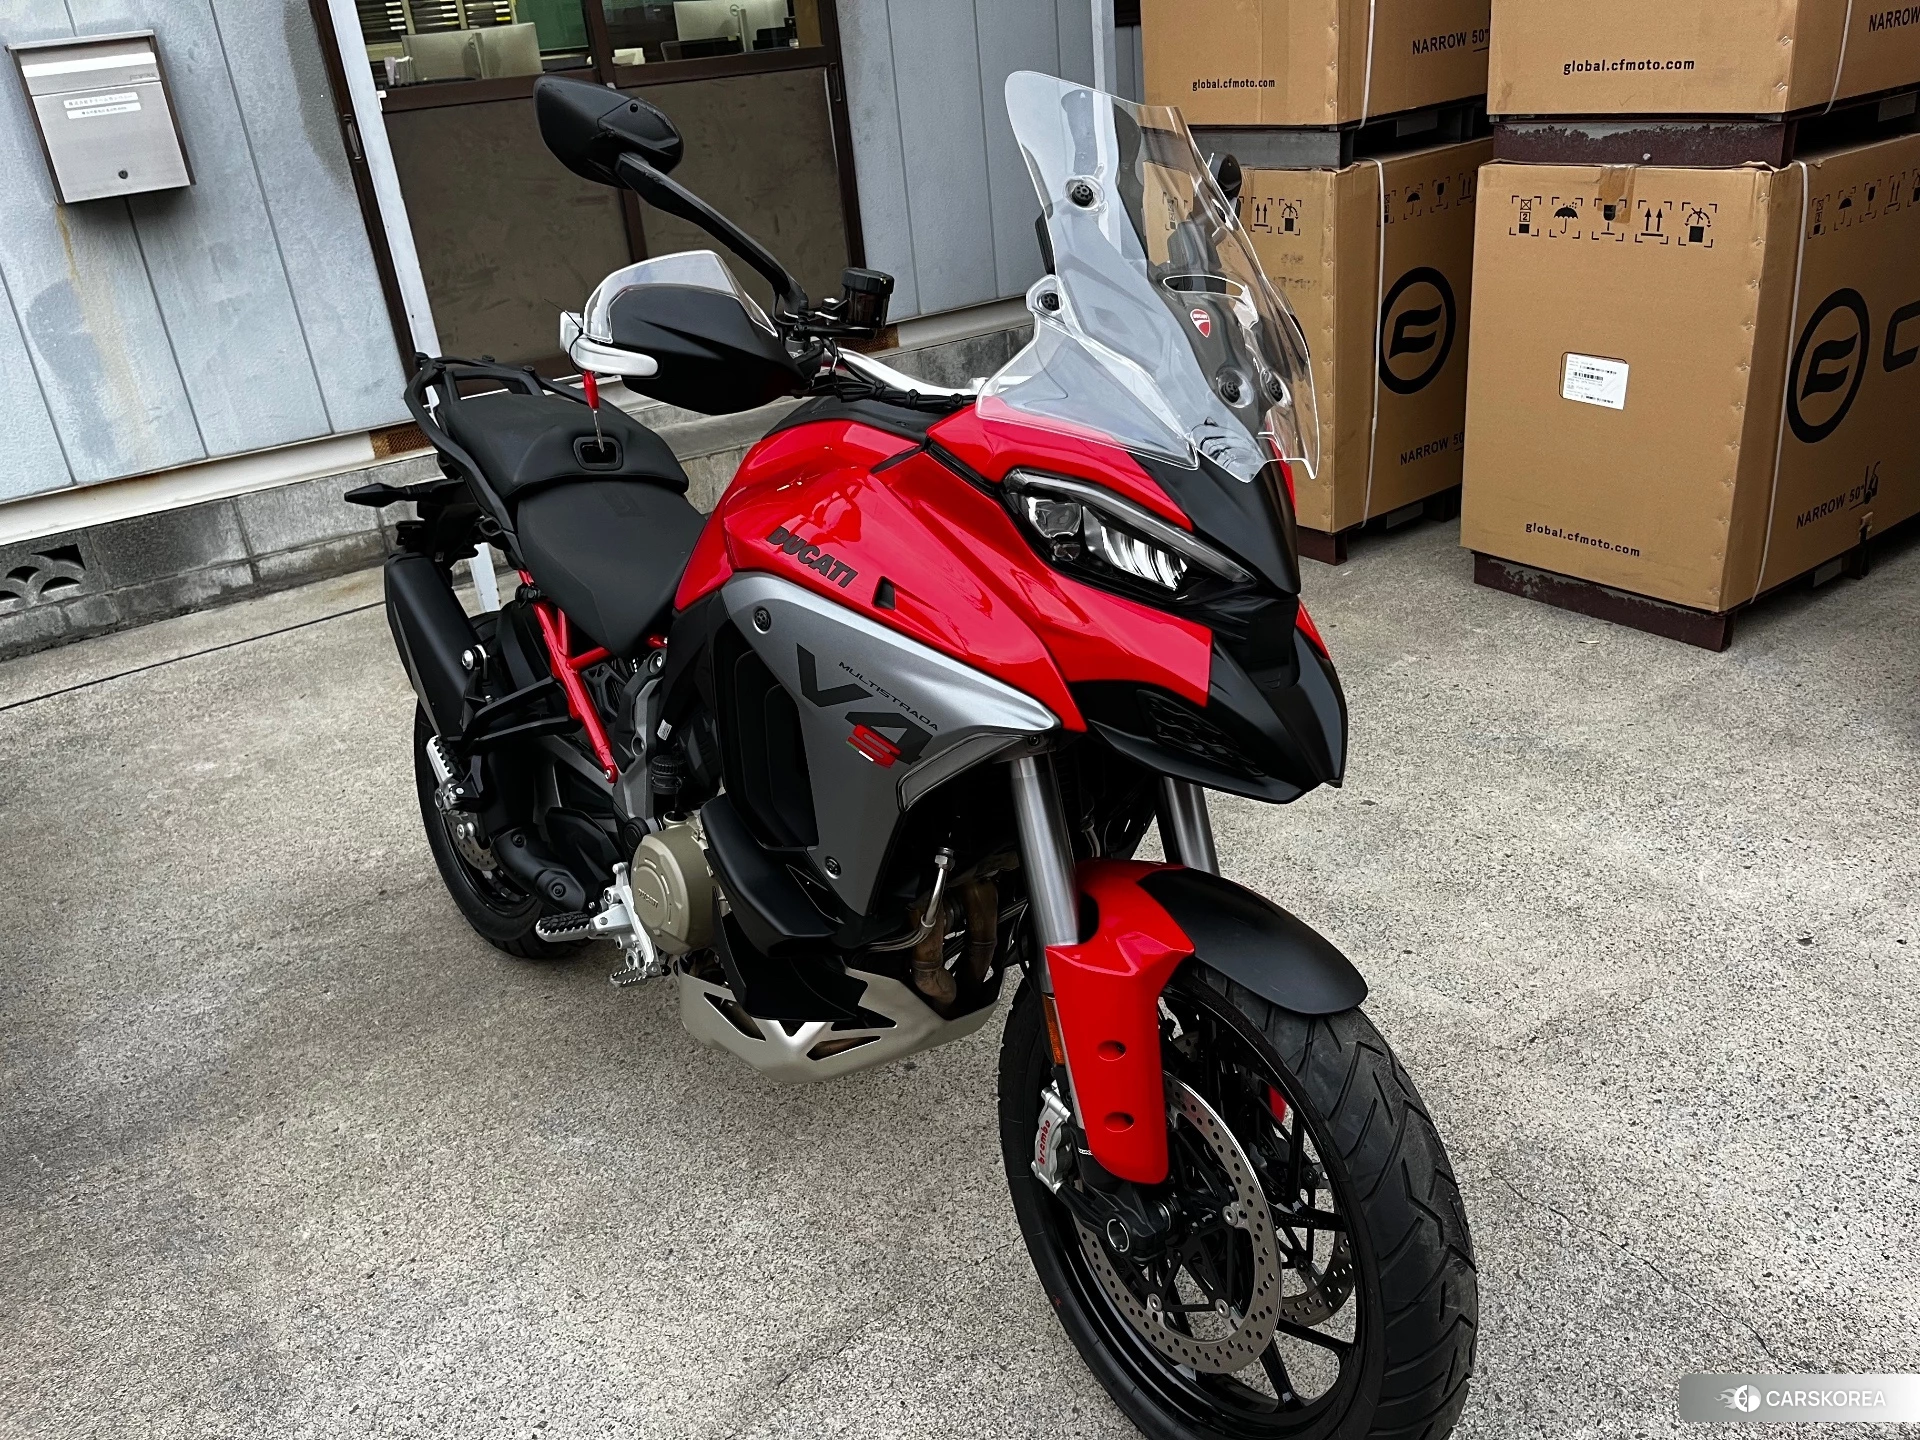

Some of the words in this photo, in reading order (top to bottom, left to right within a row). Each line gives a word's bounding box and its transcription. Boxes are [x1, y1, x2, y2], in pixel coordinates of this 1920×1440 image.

[1868, 5, 1920, 33] NARROW
[1412, 31, 1468, 55] NARROW
[1563, 58, 1696, 75] global.cfmoto.com
[1192, 77, 1276, 92] global.cfmoto.com
[1400, 436, 1449, 466] NARROW
[1796, 492, 1846, 530] NARROW
[1525, 520, 1641, 558] global.cfmoto.com
[766, 525, 859, 589] DUCATI
[838, 660, 939, 732] MULTISTRADA
[1037, 1119, 1051, 1165] brembo
